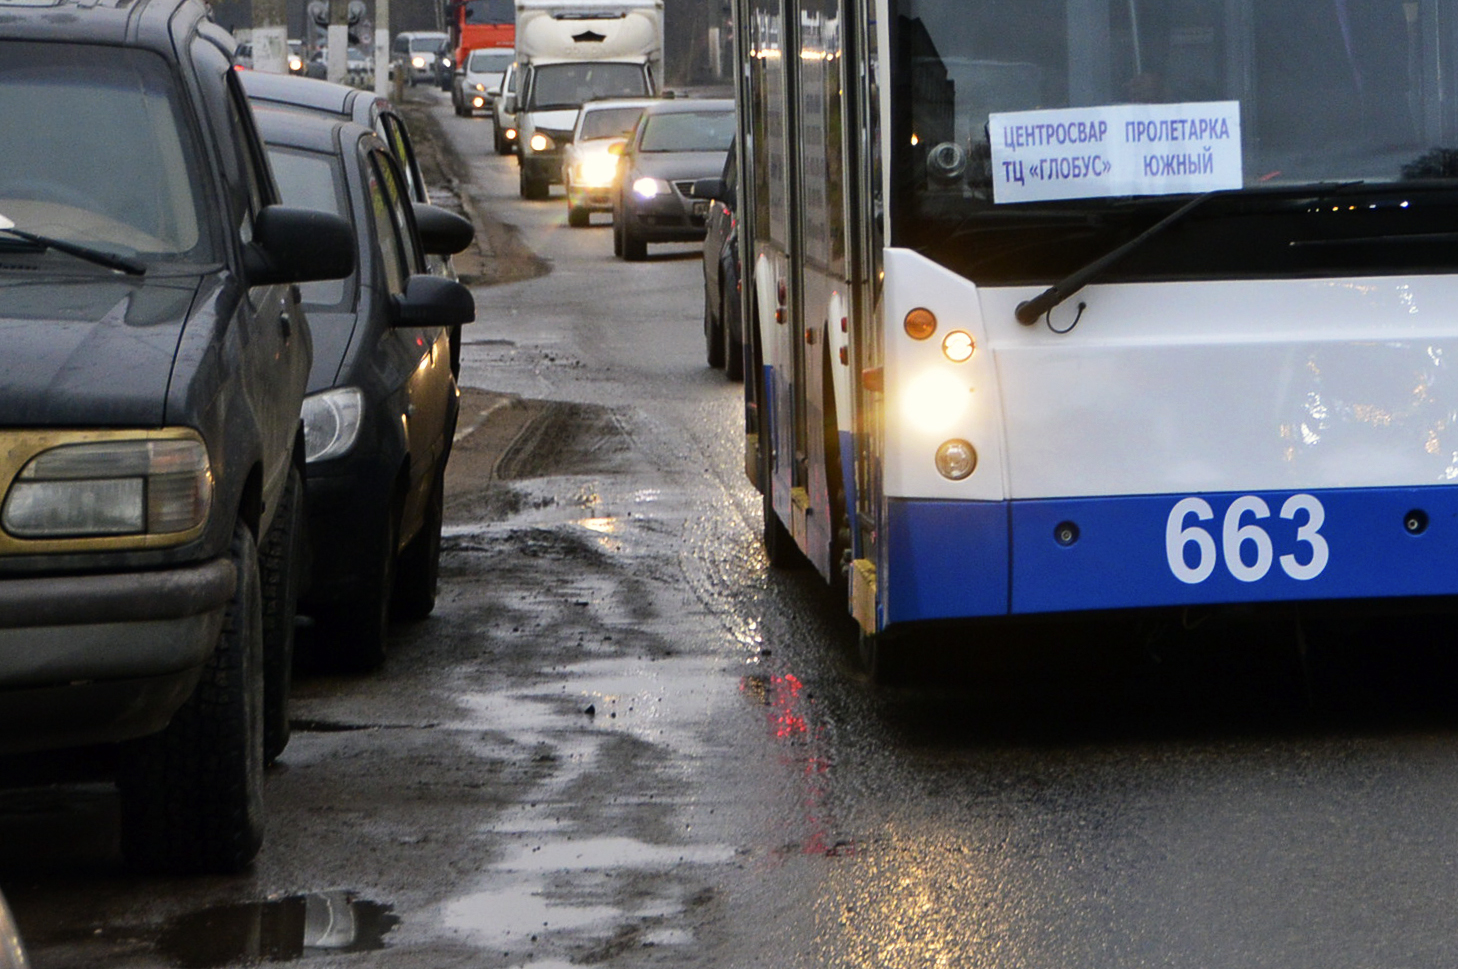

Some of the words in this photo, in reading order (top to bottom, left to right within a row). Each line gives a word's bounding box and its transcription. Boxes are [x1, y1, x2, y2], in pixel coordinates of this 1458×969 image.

[1003, 120, 1108, 152] ЦЕНТРОСВАР
[1125, 118, 1230, 143] ПРОЛЕТАРКА
[1002, 160, 1026, 186] ТЦ
[1029, 155, 1112, 181] «ГЛОБУС»
[1143, 146, 1214, 177] ЮЖНЫЙ
[1165, 493, 1330, 585] 663
